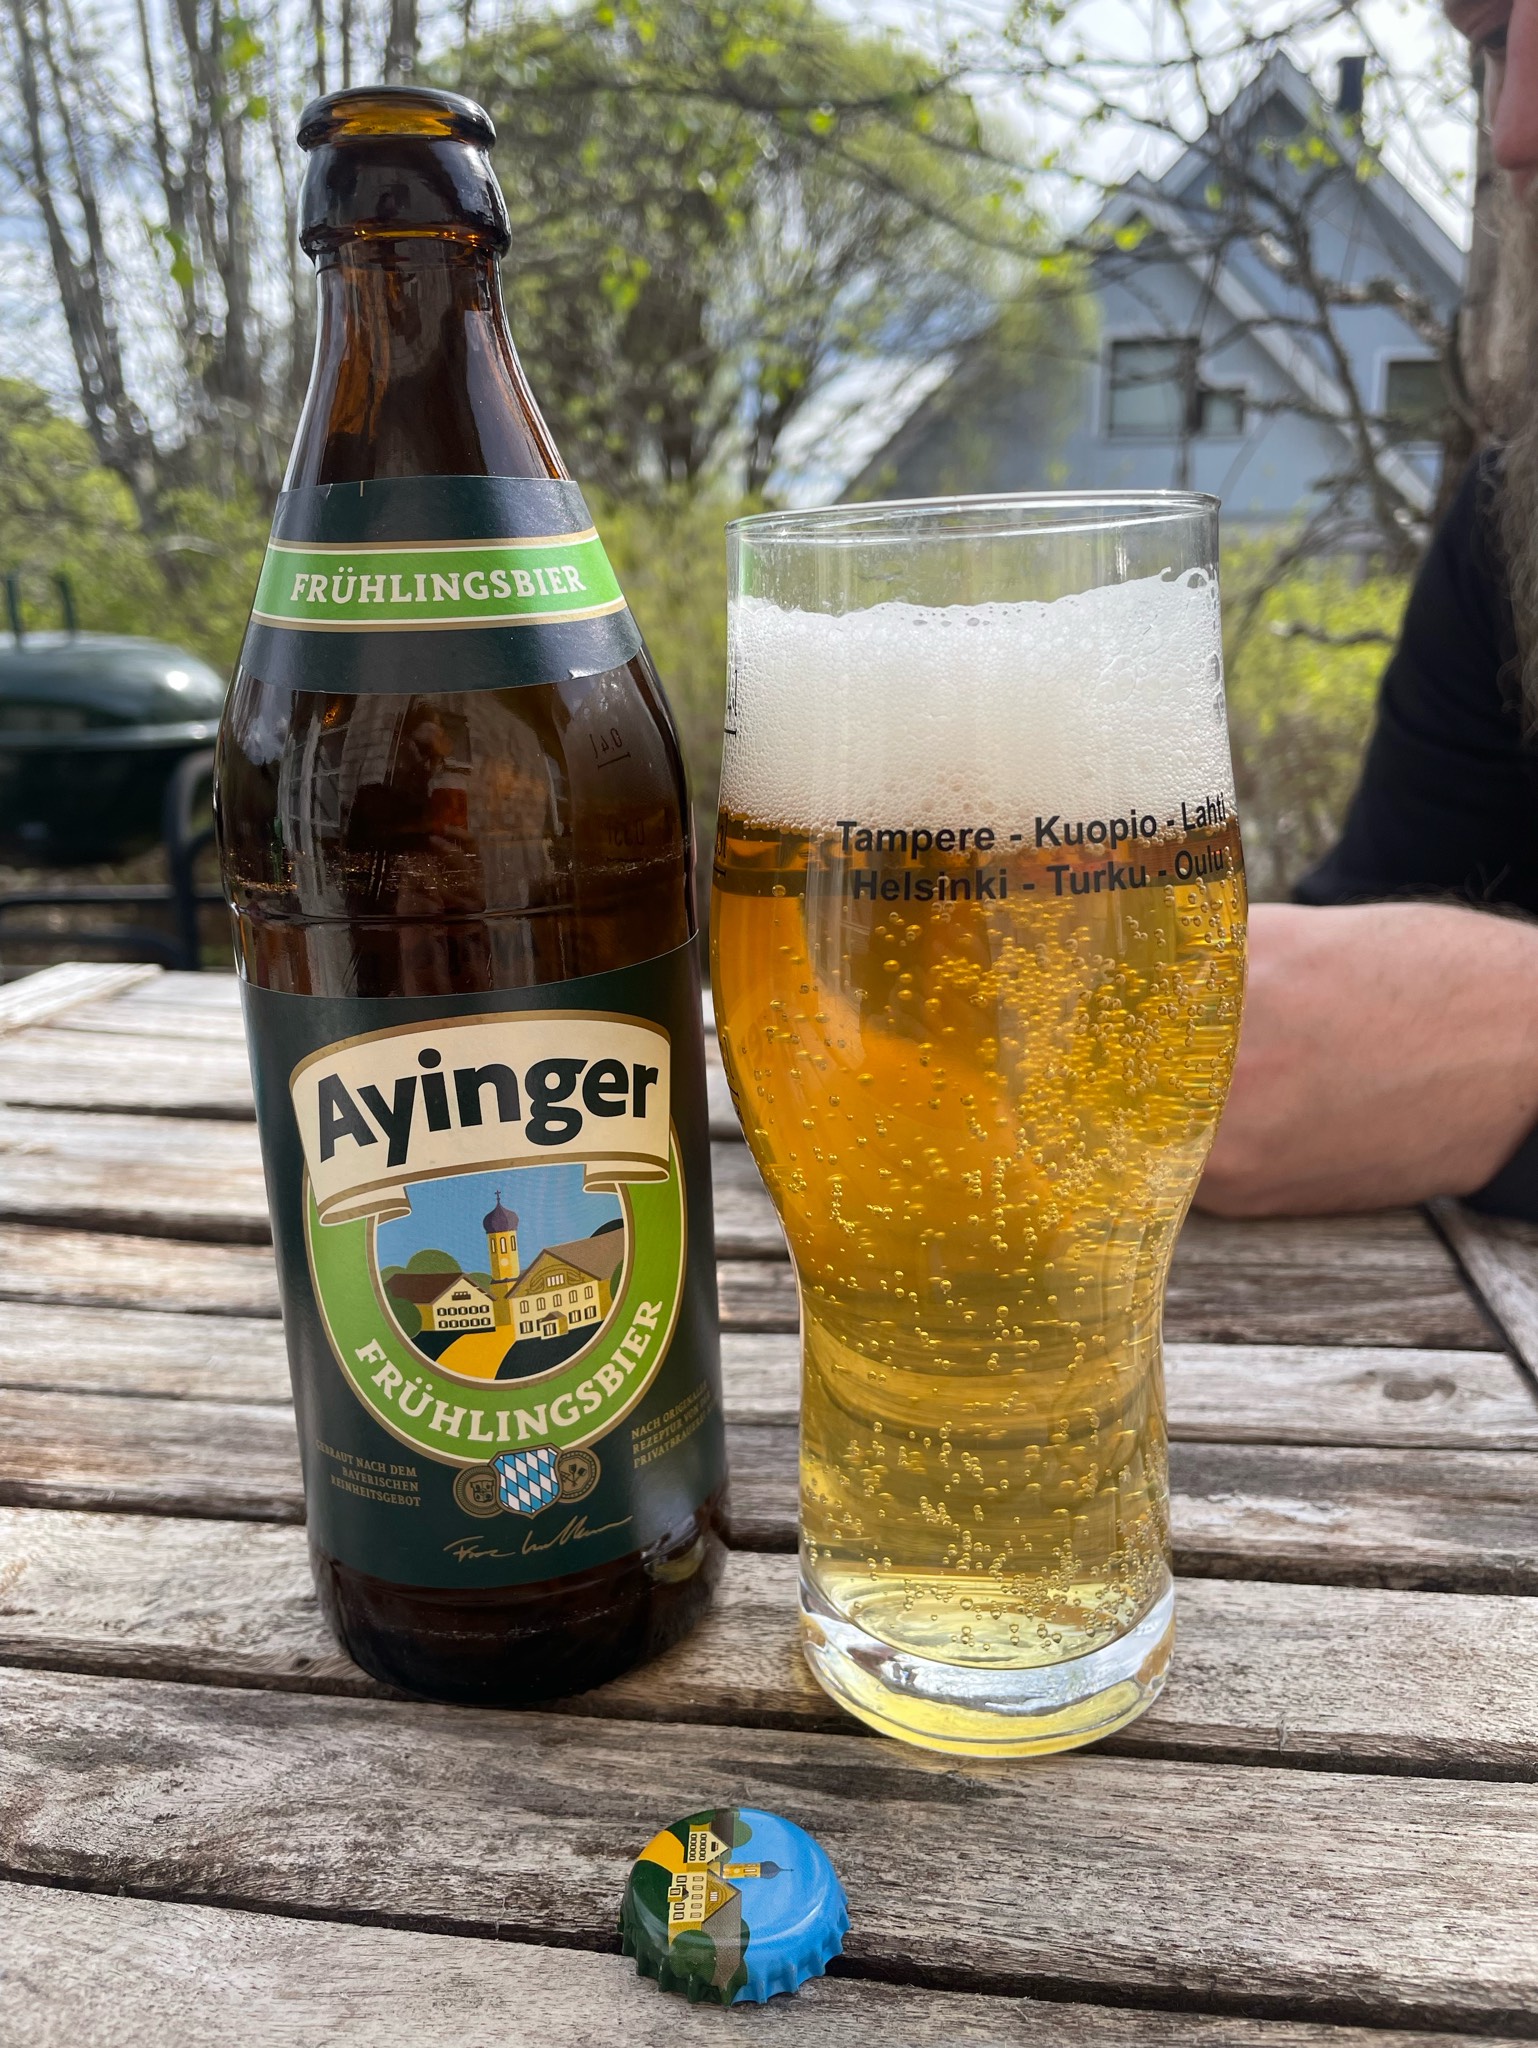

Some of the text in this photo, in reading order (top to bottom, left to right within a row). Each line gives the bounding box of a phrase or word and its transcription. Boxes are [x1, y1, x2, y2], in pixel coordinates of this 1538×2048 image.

[290, 564, 587, 604] FRÜHLINGSBIER
[836, 820, 995, 855] Tampere
[1035, 808, 1158, 850] Kuopio
[1181, 791, 1227, 831] Lahti
[853, 868, 1007, 901] Helsinki
[1047, 861, 1147, 897] Turku
[1174, 844, 1224, 880] Oulu
[318, 1048, 659, 1168] Ayinger
[355, 1300, 663, 1442] FRÜHLINGSBIER
[631, 1416, 661, 1440] NACH
[632, 1418, 682, 1455] REZEPTUR
[315, 1439, 418, 1477] GEBRAUT NACH DEM
[330, 1473, 421, 1507] REINHEITSGEBOT
[342, 1465, 419, 1492] BAYERISCHEN
